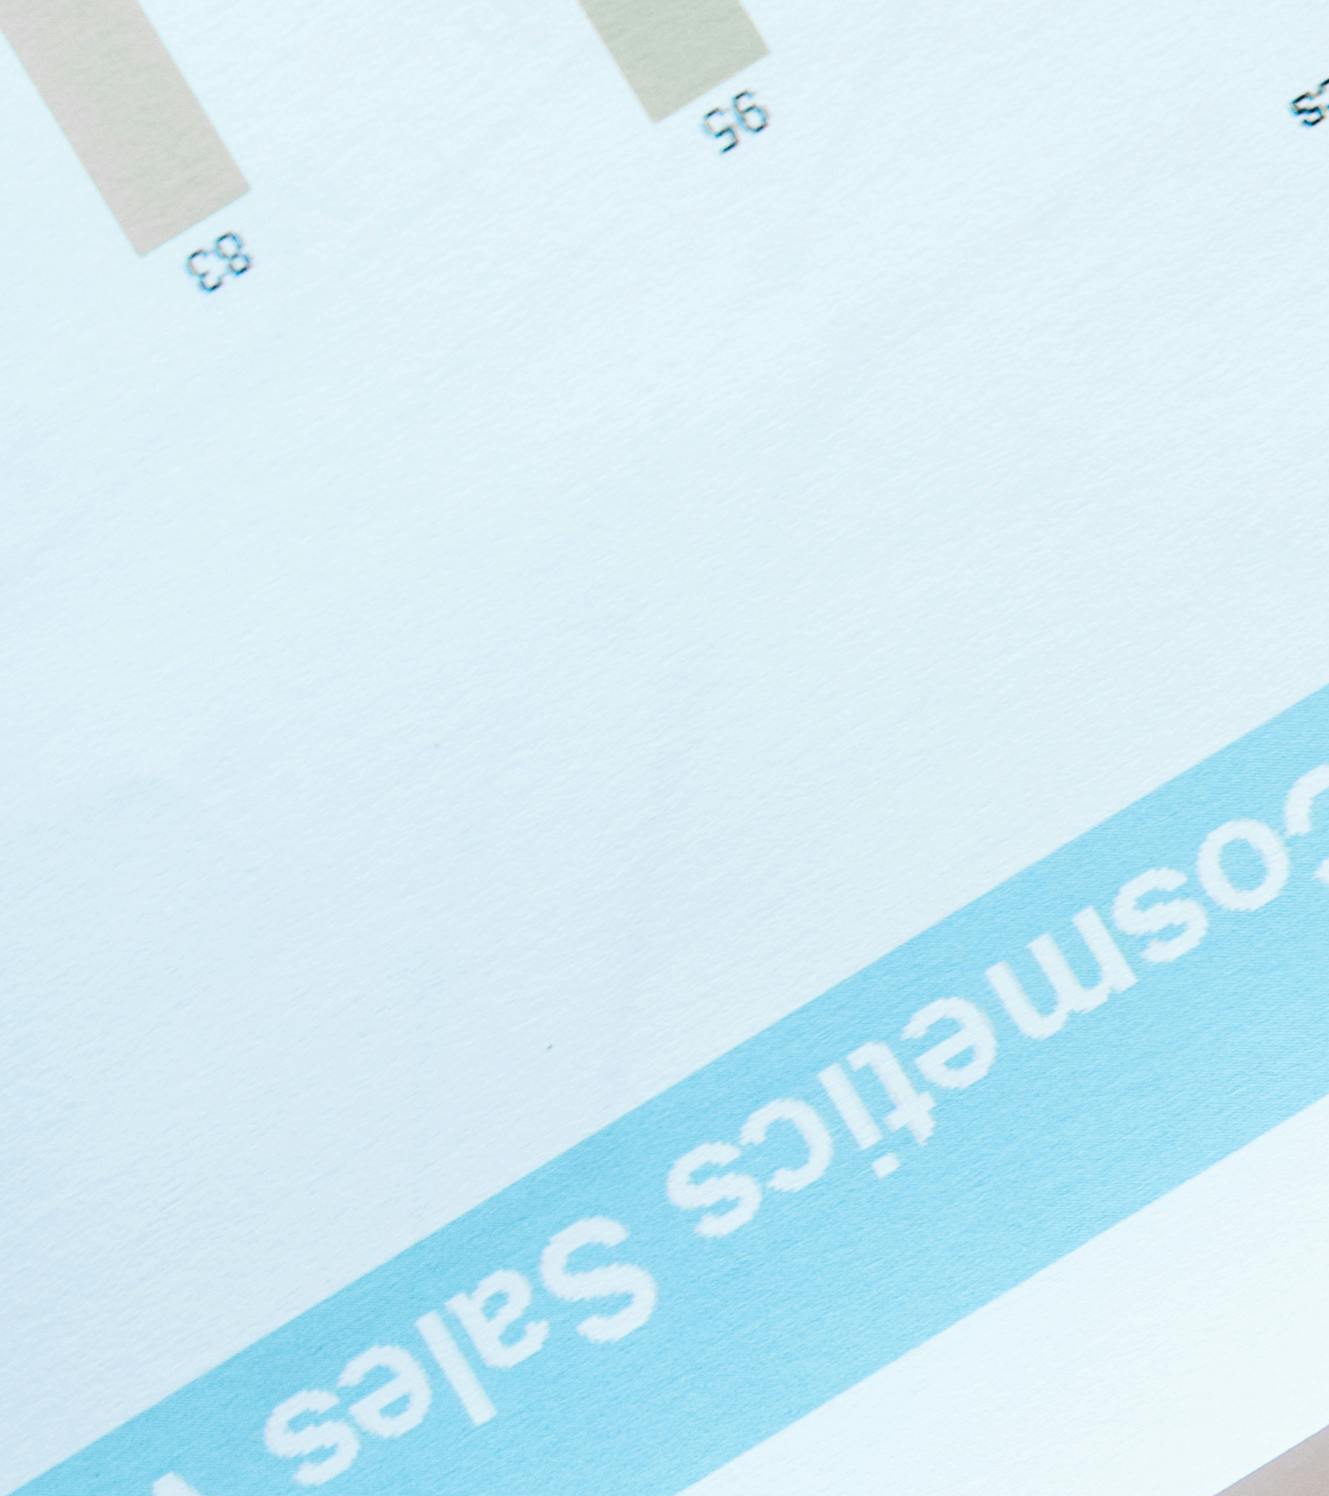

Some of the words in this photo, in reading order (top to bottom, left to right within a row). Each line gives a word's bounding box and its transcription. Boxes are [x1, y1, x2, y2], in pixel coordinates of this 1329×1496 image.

[702, 89, 770, 155] 95
[186, 231, 253, 294] 83
[263, 1217, 658, 1487] Sales
